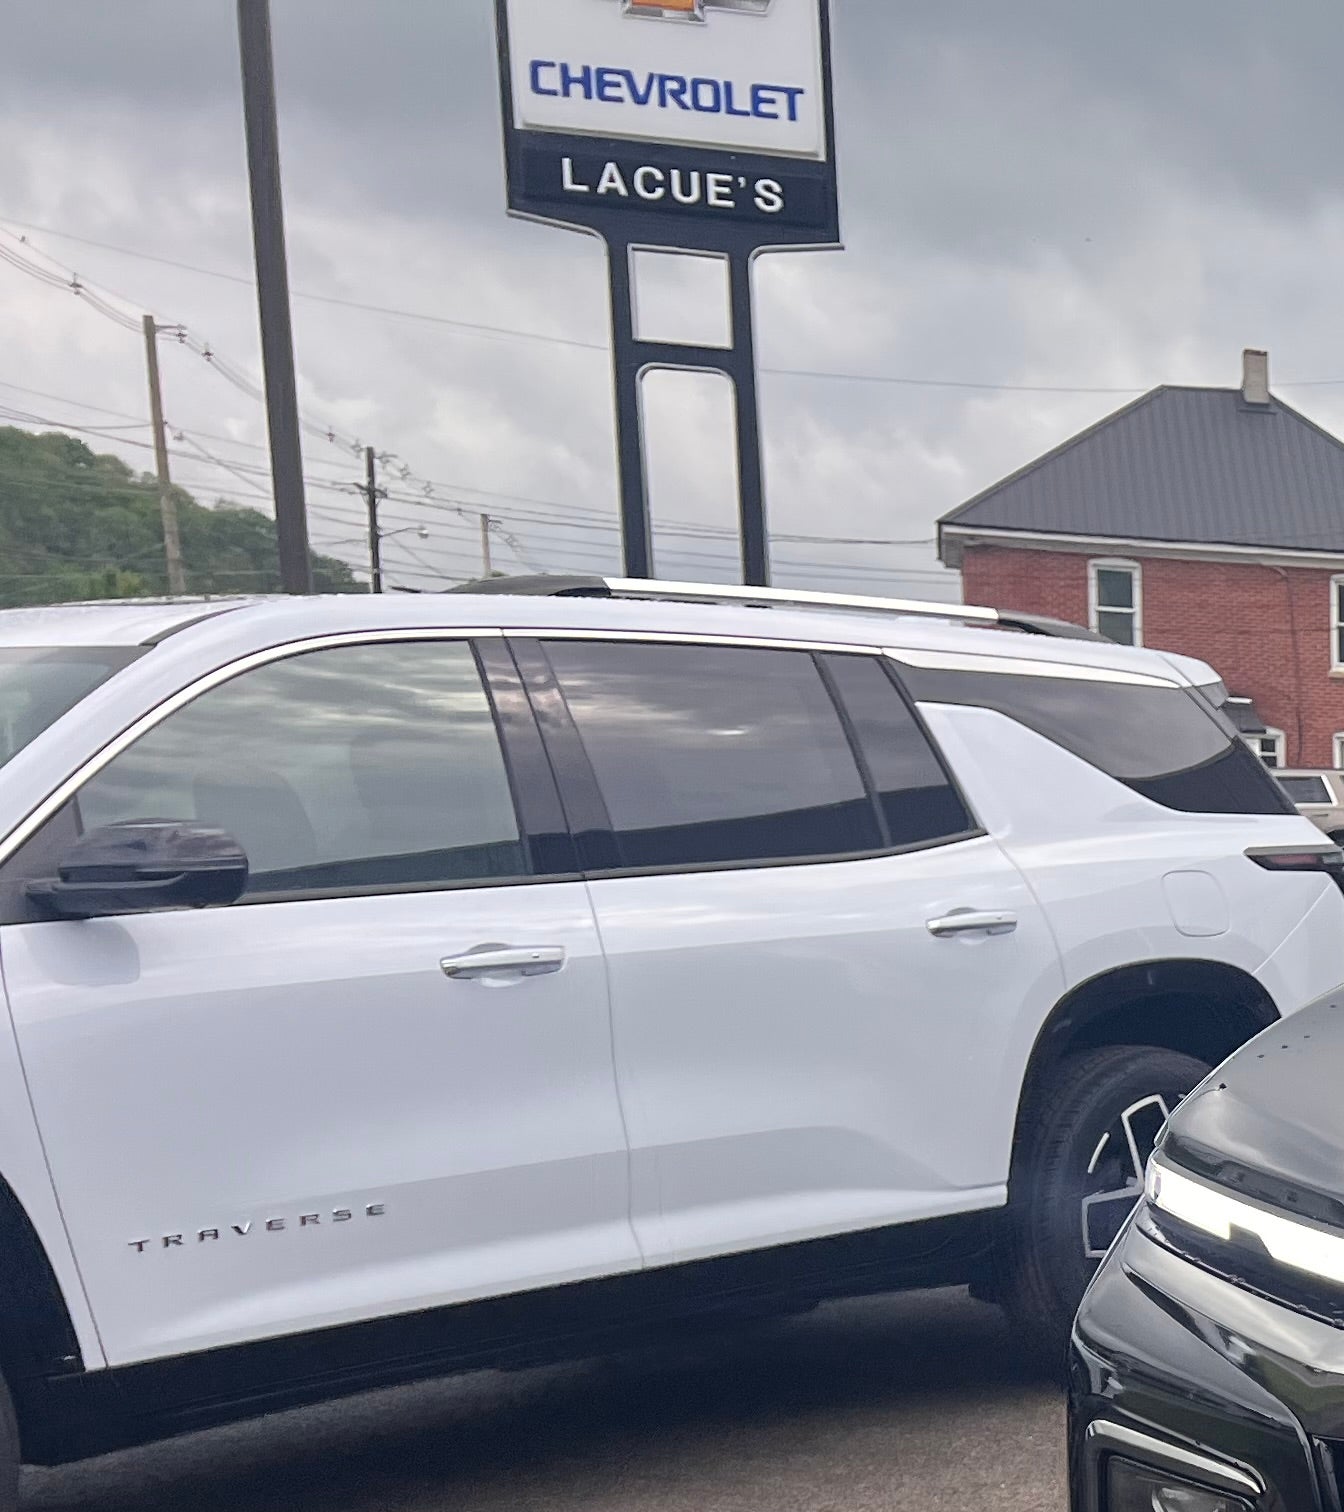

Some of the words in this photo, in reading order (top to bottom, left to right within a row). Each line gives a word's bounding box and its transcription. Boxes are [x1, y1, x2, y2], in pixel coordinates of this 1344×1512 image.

[530, 59, 804, 121] CHEVROLET
[560, 157, 784, 213] LACUE'S
[127, 1202, 386, 1253] TRAVERSE
